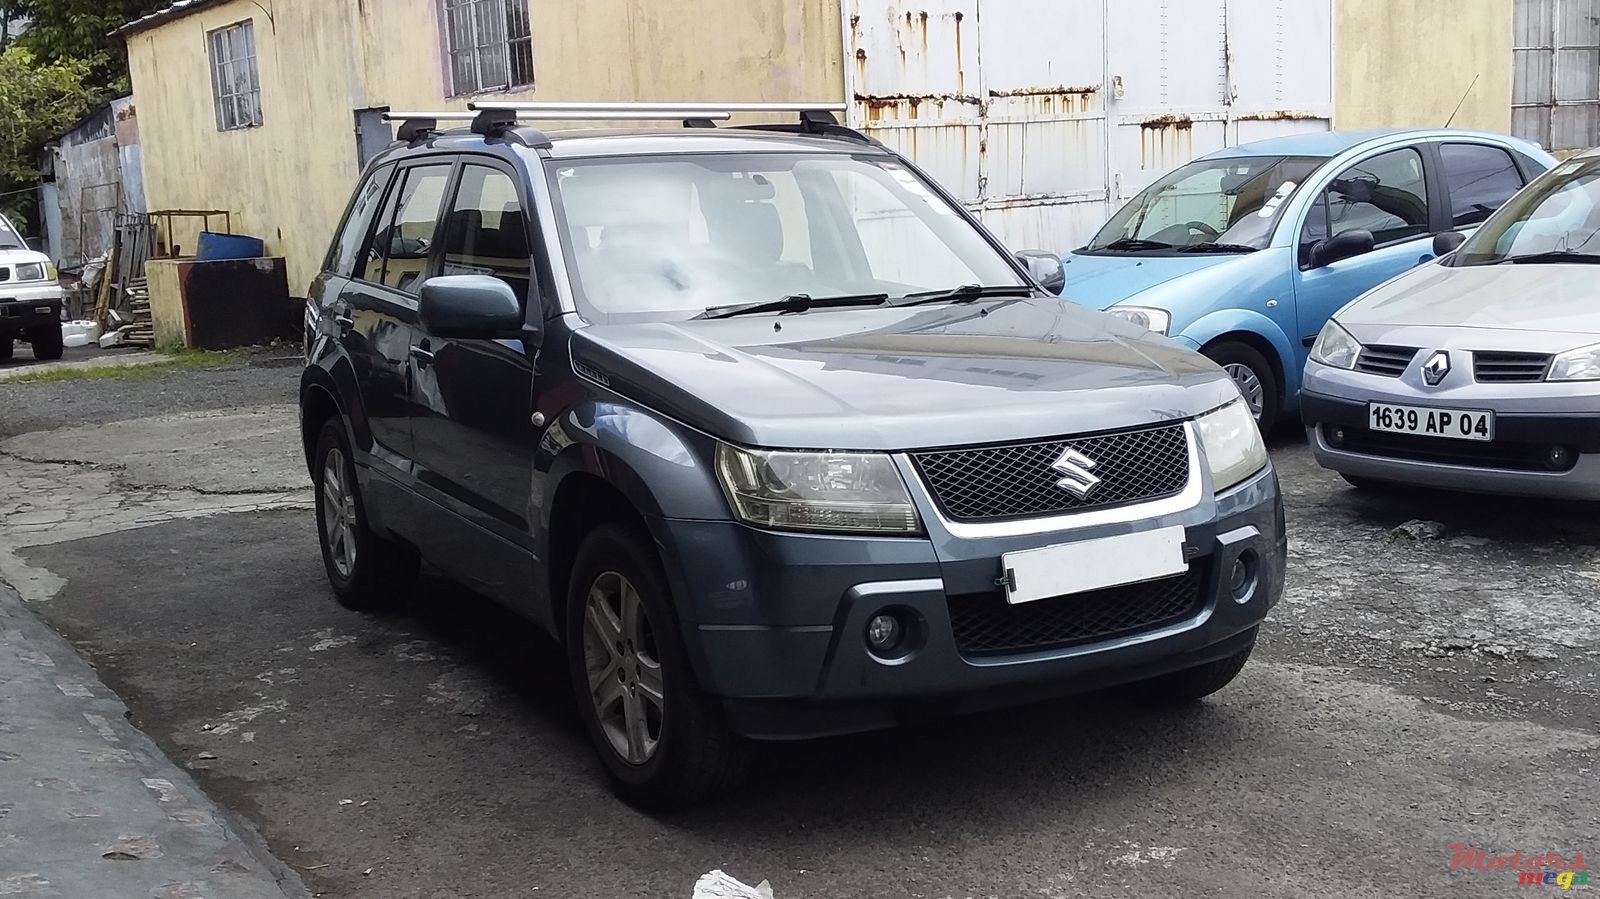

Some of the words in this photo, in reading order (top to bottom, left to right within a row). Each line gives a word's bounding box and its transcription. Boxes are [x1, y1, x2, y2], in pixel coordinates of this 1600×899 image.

[1372, 405, 1418, 431] 1639
[1425, 411, 1452, 434] AP
[1460, 413, 1488, 437] 04
